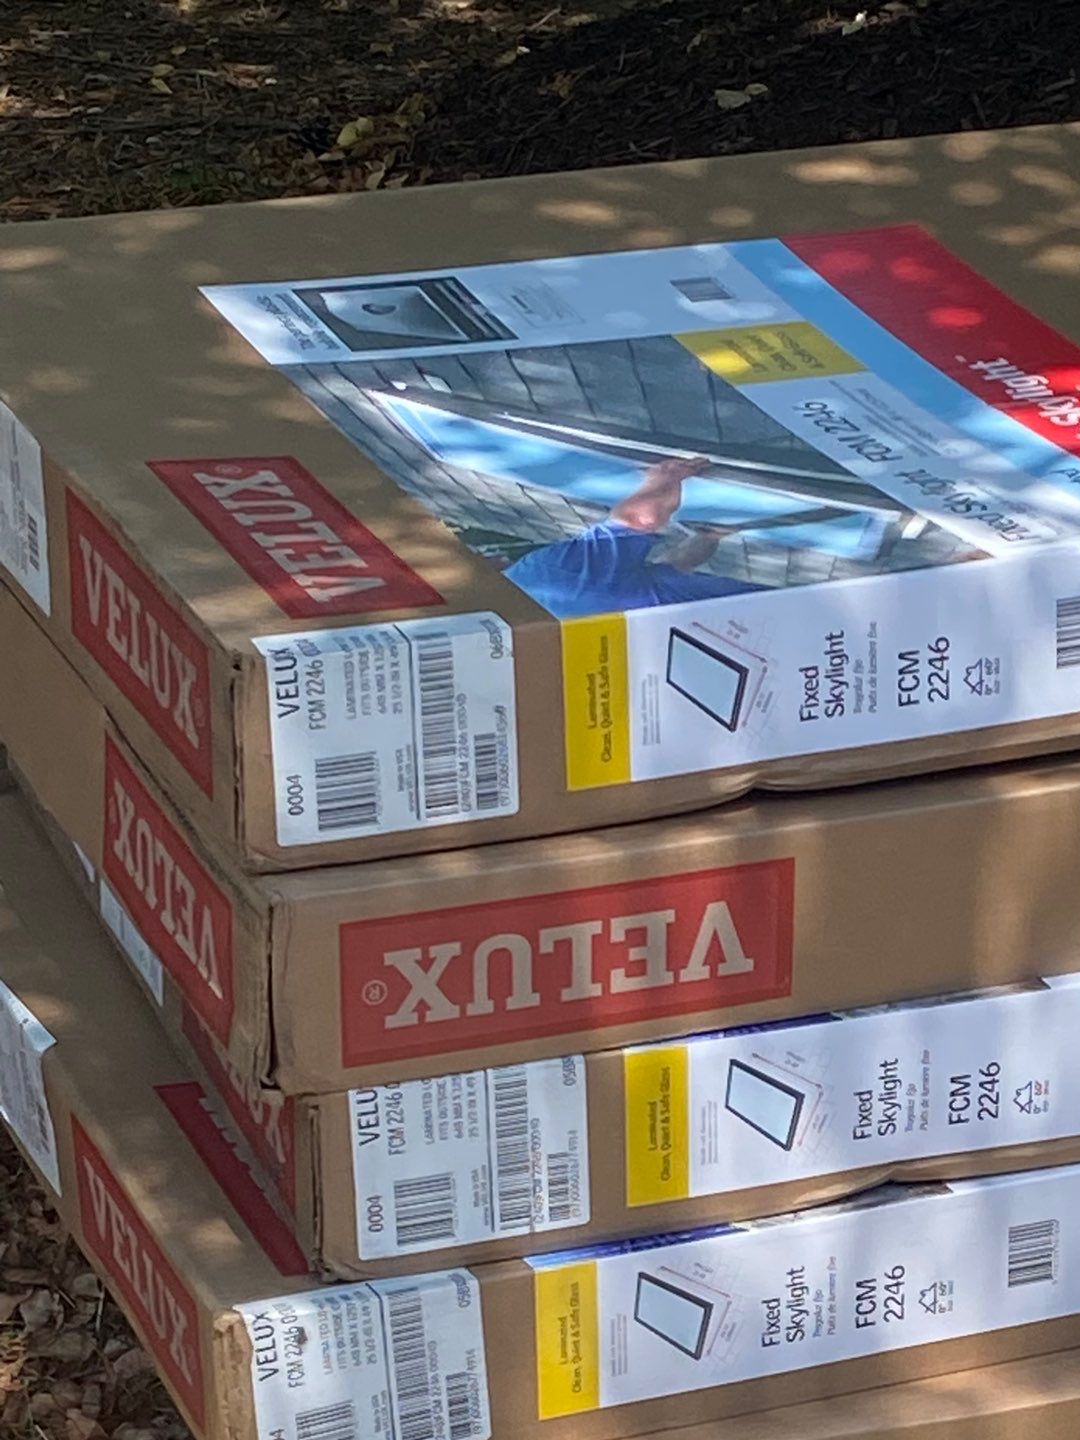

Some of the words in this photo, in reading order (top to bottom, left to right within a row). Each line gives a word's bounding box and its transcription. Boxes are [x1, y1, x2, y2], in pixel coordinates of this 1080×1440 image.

[192, 468, 388, 603] VELUX
[79, 533, 200, 750] VELUX
[927, 636, 950, 702] 2246
[267, 647, 301, 719] VELUX
[305, 659, 326, 696] 2246
[798, 665, 820, 722] Fixed
[824, 629, 850, 718] Skylight
[898, 649, 920, 707] FCM
[308, 700, 328, 731] FCM
[286, 773, 304, 816] 0004
[113, 777, 224, 1001] VELUX
[355, 1087, 381, 1147] VELU
[383, 1091, 403, 1123] 2246
[853, 1090, 873, 1140] Fixed
[877, 1058, 902, 1136] Skylight
[948, 1074, 971, 1125] FCM
[977, 1061, 1001, 1121] 2246
[82, 1155, 194, 1387] VELUX
[884, 1264, 905, 1323] 2246
[760, 1297, 781, 1348] Fixed
[785, 1265, 809, 1343] Skylight
[855, 1278, 878, 1329] FCM
[252, 1310, 279, 1382] VELUX
[284, 1325, 302, 1357] 2246
[287, 1359, 306, 1388] FCM
